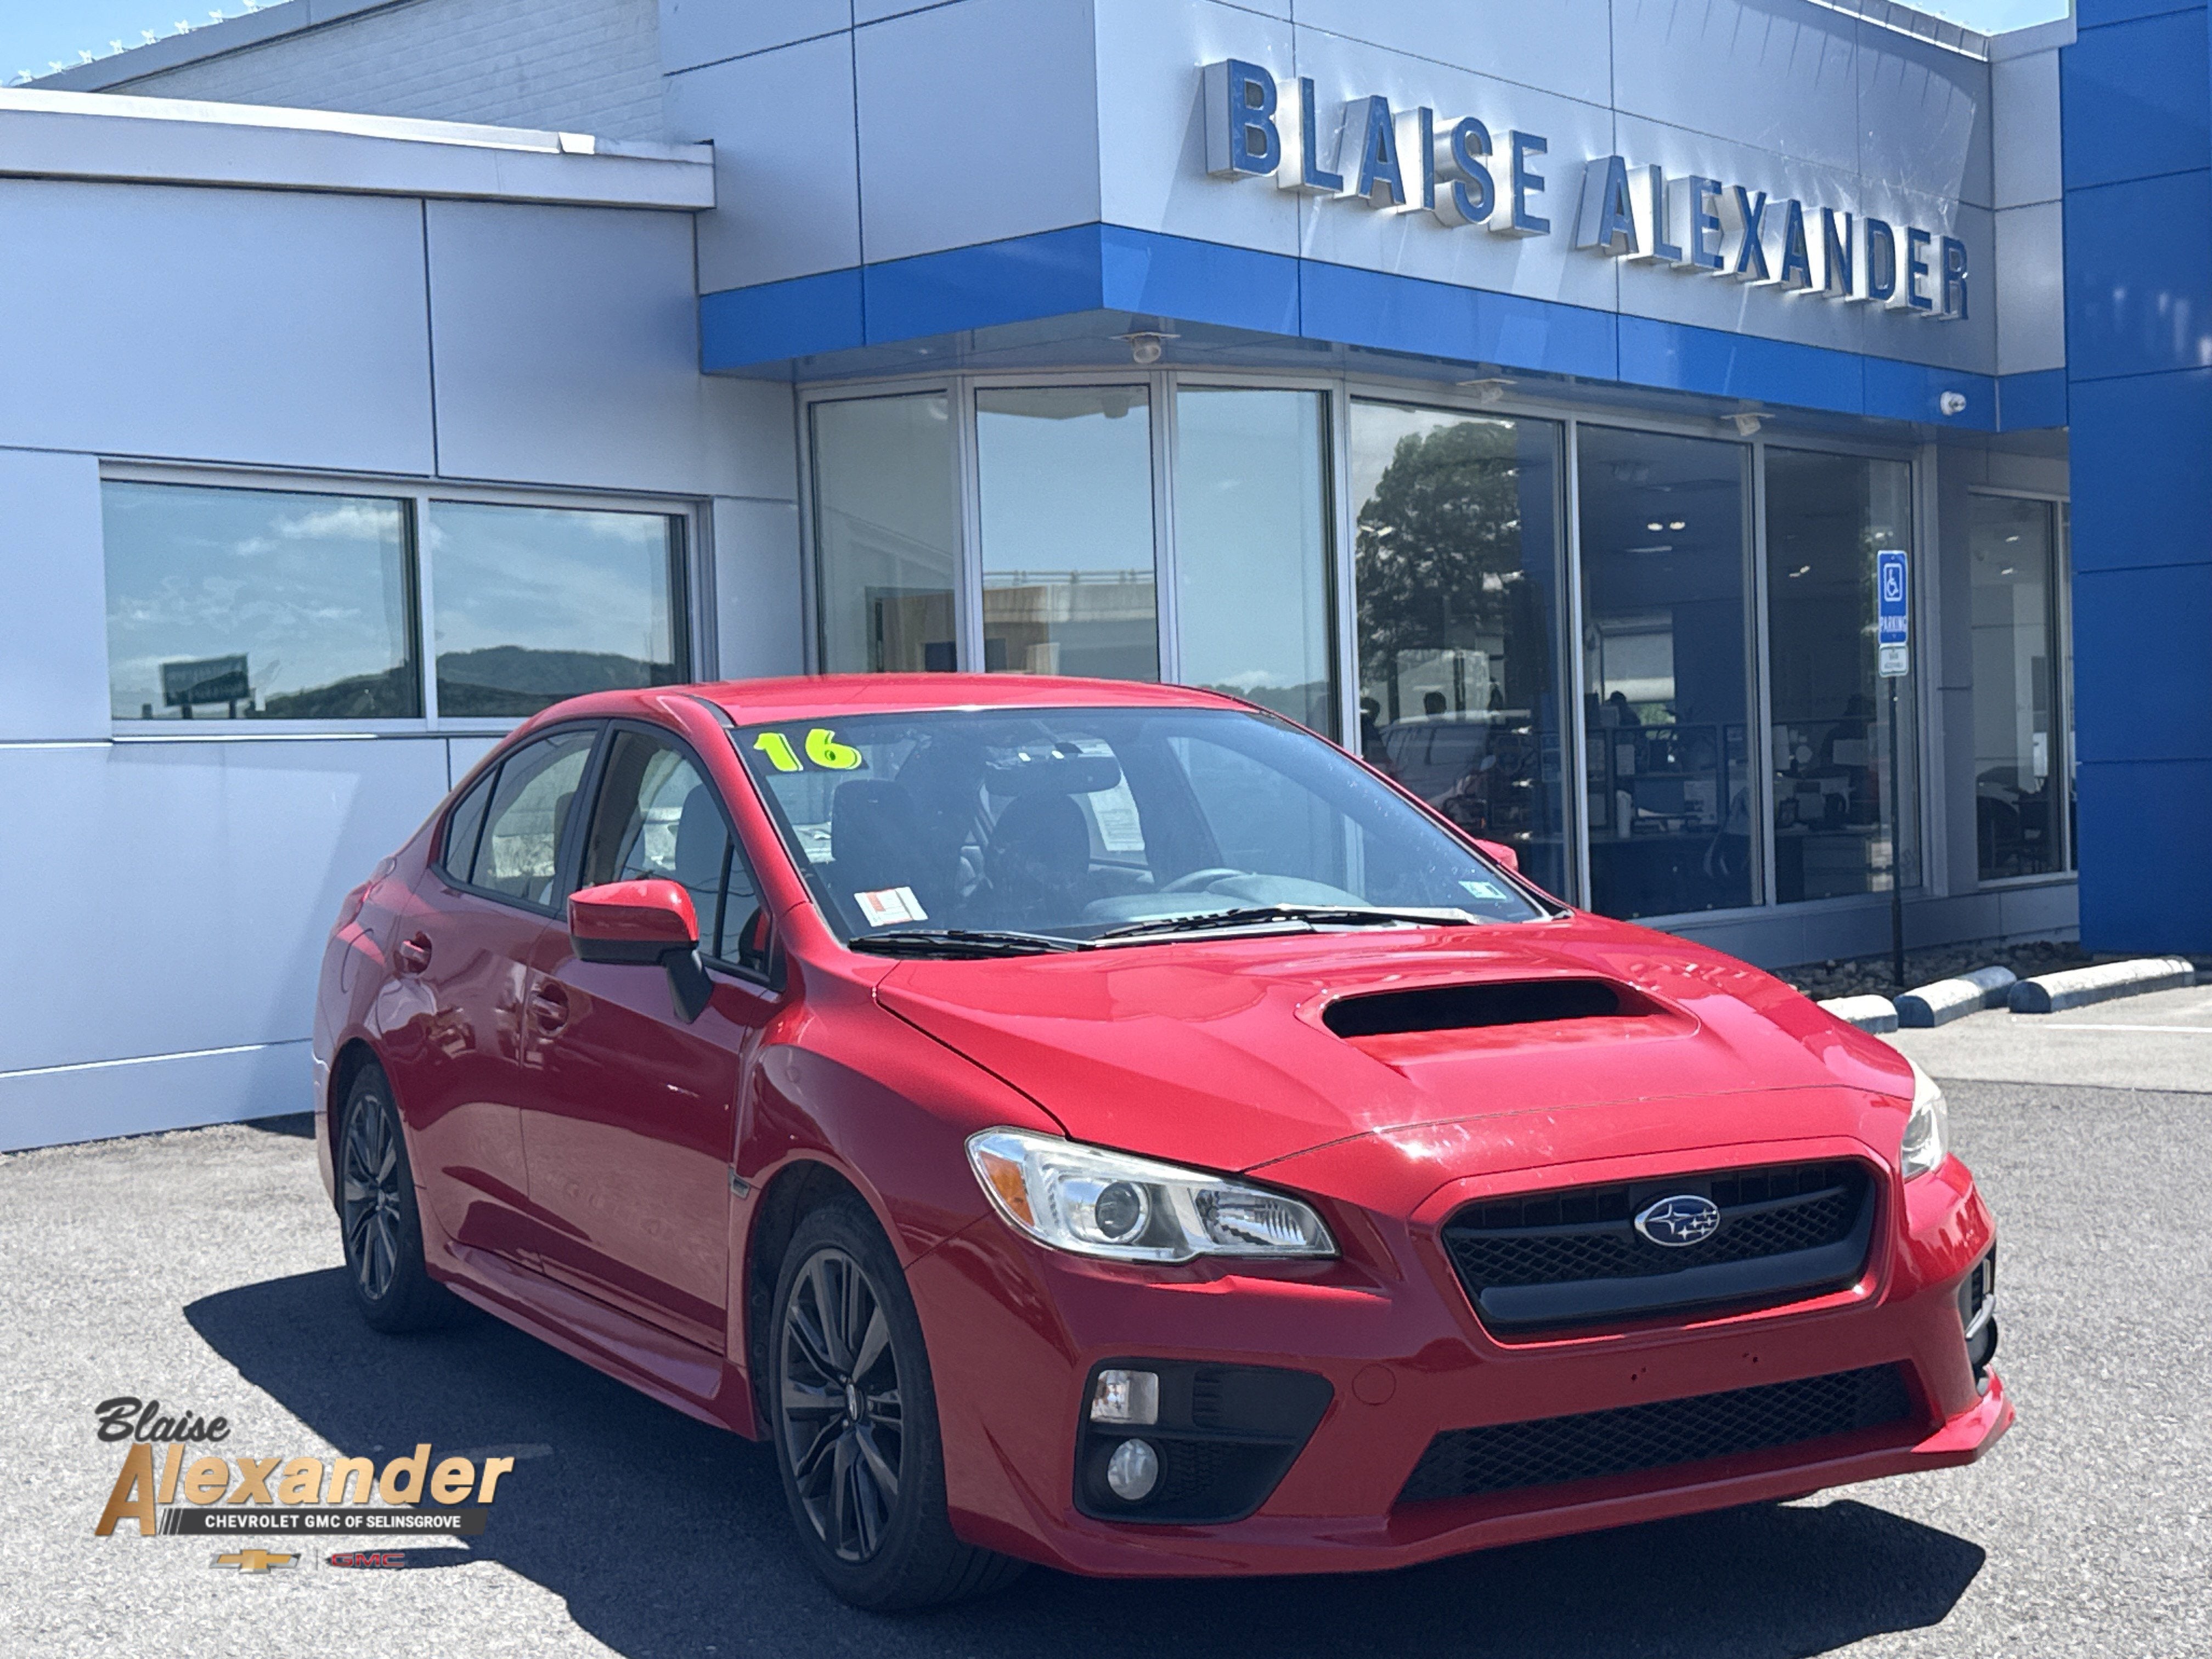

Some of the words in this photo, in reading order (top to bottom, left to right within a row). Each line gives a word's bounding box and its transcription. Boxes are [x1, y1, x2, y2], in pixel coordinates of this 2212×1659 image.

[1224, 57, 1551, 235] BLAISE
[1595, 154, 1970, 321] ALEXANDER
[1880, 616, 1906, 633] PARKING
[753, 728, 862, 772] 16
